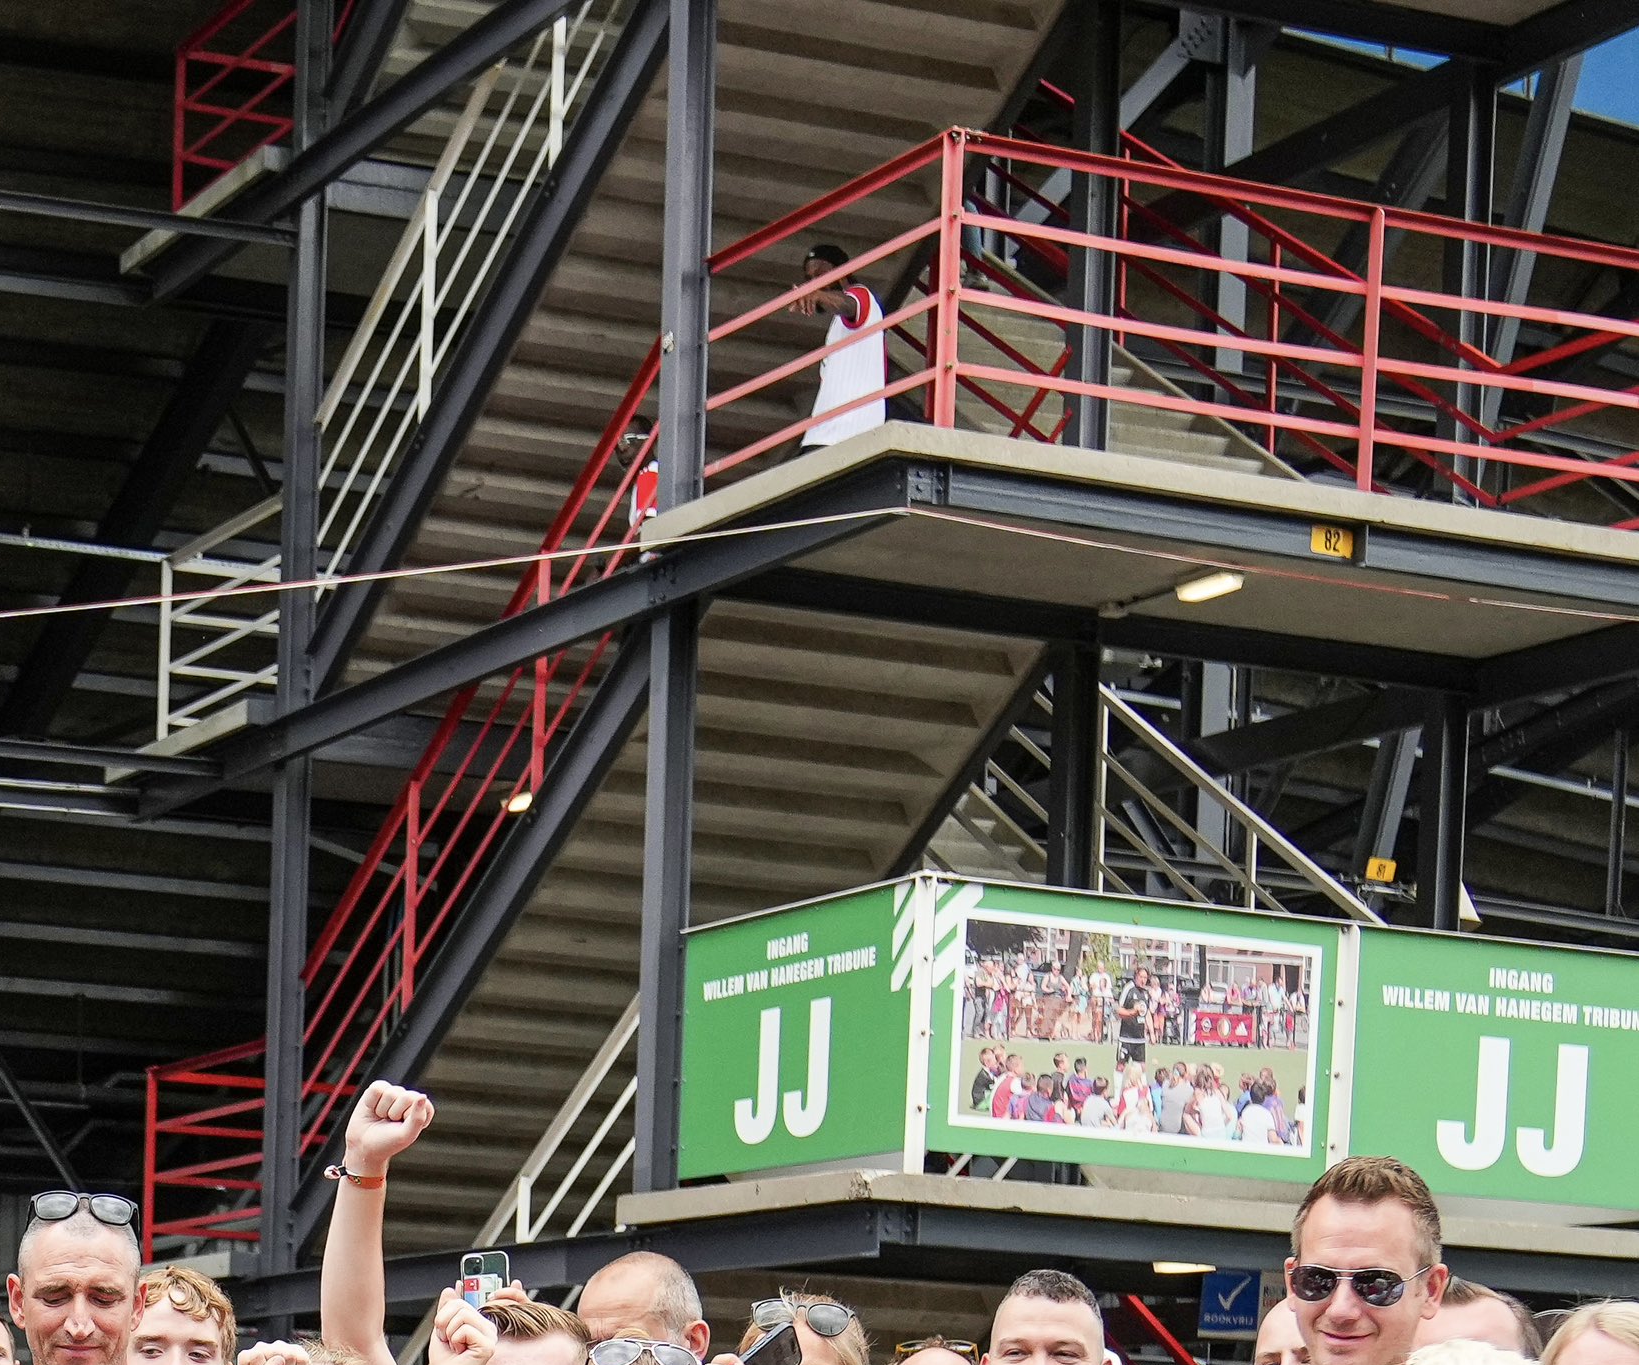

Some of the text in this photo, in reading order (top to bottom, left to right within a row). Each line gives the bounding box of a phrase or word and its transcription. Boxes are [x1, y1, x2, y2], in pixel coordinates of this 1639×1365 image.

[1324, 529, 1341, 553] 82
[767, 932, 810, 961] INGANG
[703, 945, 877, 1002] WILLEM VAN HANEGEM TRIBUNE
[1489, 967, 1555, 994] INGANG
[1382, 984, 1451, 1012] WILLEM
[1455, 992, 1490, 1016] VAN
[1495, 996, 1579, 1025] HANEGEM
[734, 996, 833, 1145] JJ
[1436, 1035, 1590, 1178] JJ
